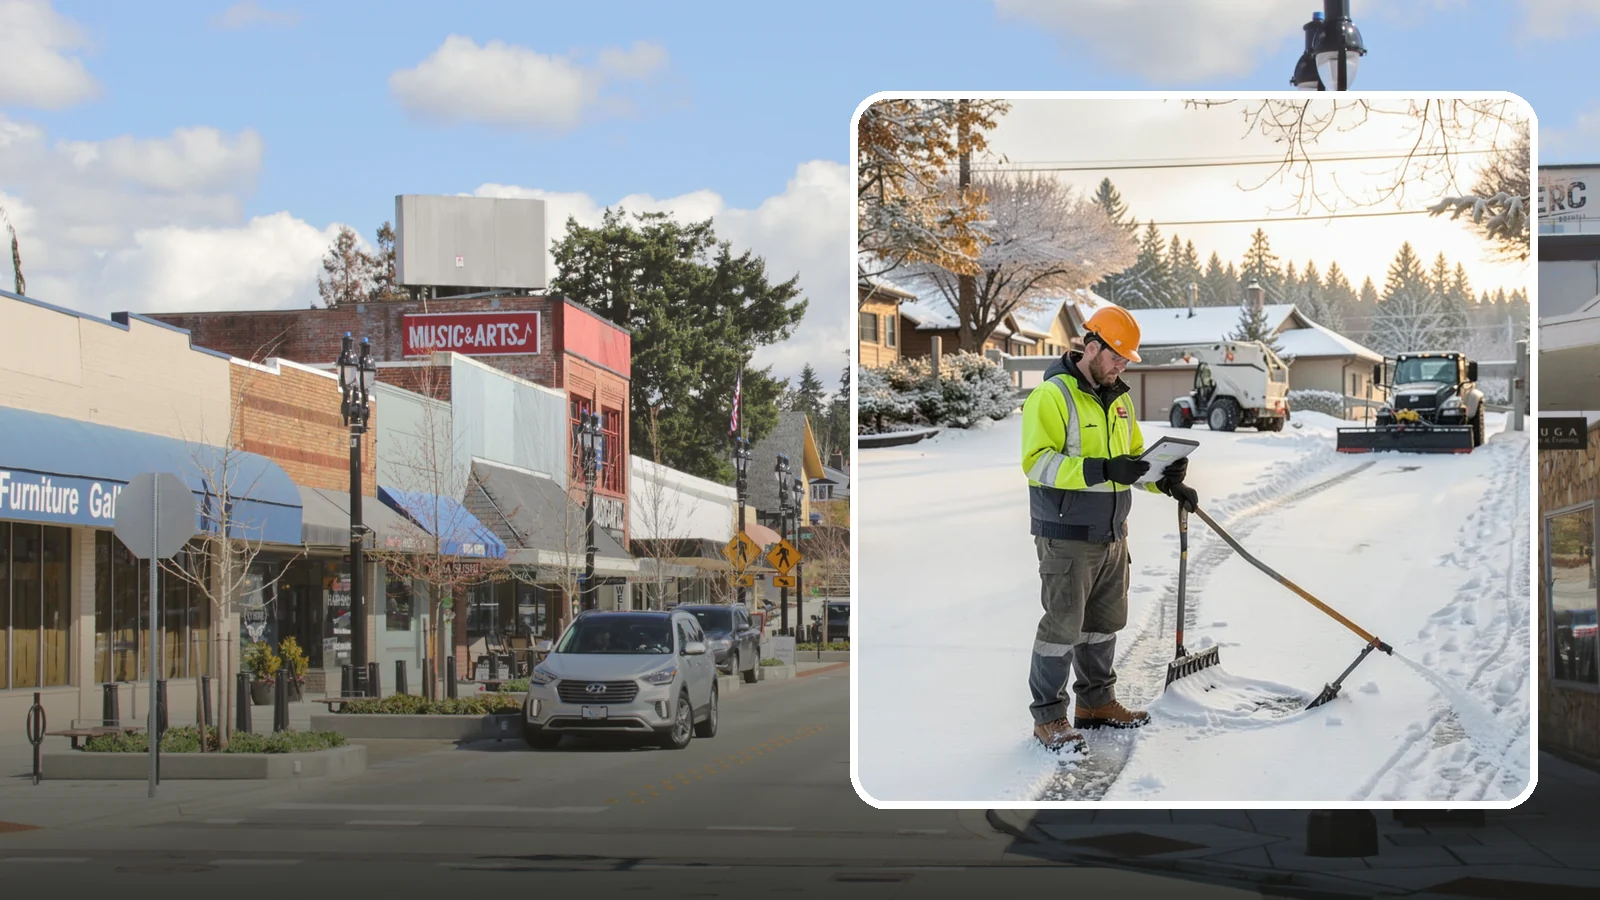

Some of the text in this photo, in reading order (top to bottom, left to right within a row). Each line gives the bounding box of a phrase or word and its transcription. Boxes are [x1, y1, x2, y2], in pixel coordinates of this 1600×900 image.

[0, 472, 122, 519] Furniture Gal
[453, 563, 479, 575] SUSHI
